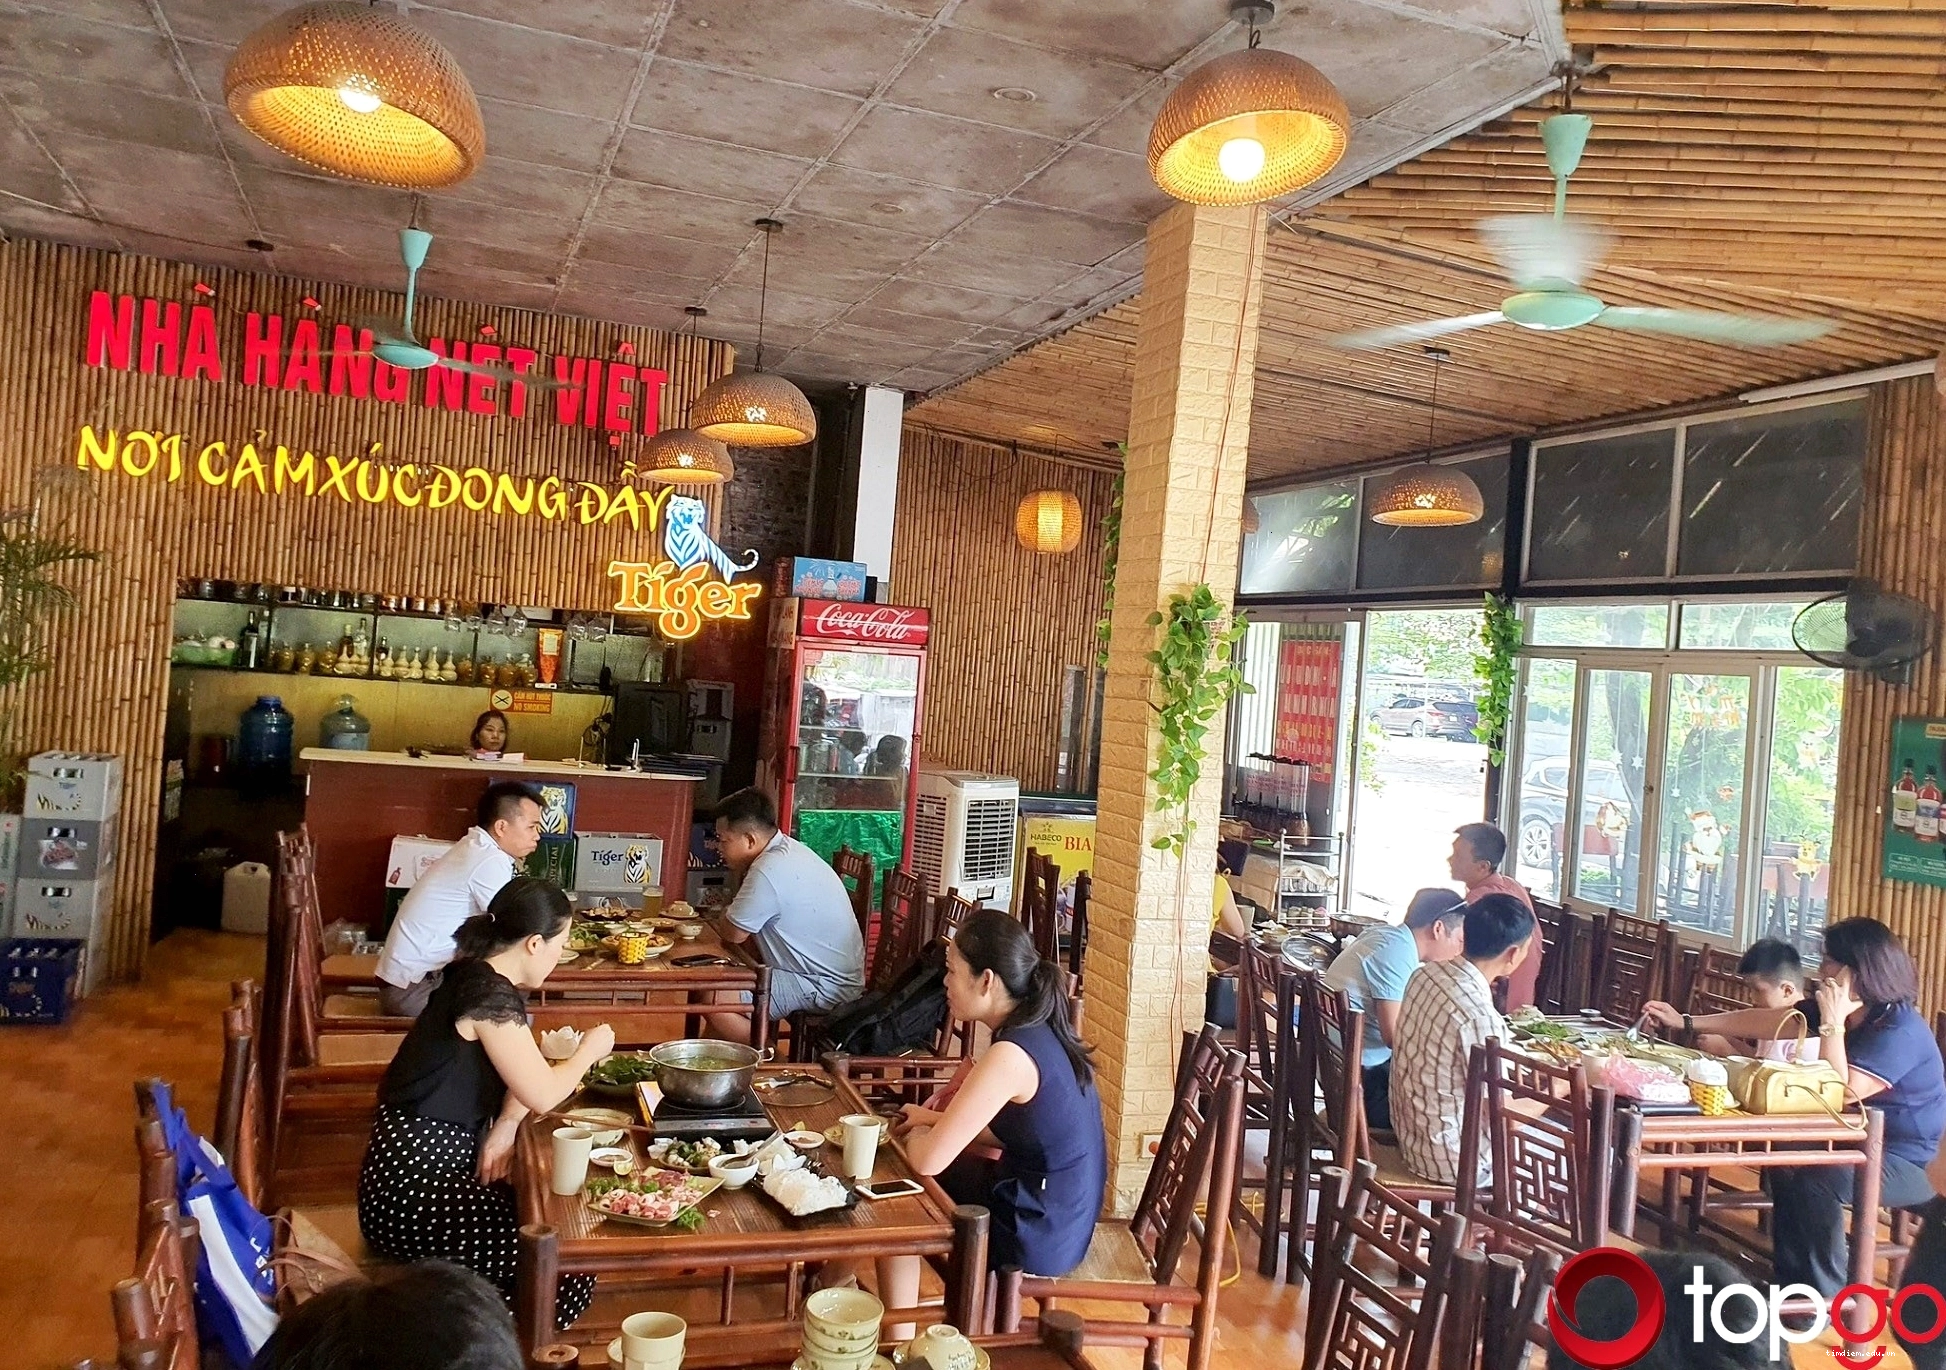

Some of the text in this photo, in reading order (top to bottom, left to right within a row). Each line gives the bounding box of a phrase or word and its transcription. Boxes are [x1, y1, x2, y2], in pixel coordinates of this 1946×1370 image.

[86, 282, 668, 447] NHÀ HÀNG NÉT VIỆT
[198, 428, 315, 496] CẢM
[318, 442, 421, 507] XÚC
[424, 463, 567, 521] ĐONG
[606, 560, 763, 640] Tiger
[816, 603, 915, 640] Coca-Cola
[1030, 833, 1062, 842] HABECO
[1064, 835, 1093, 851] BIA
[591, 849, 625, 866] Tiger
